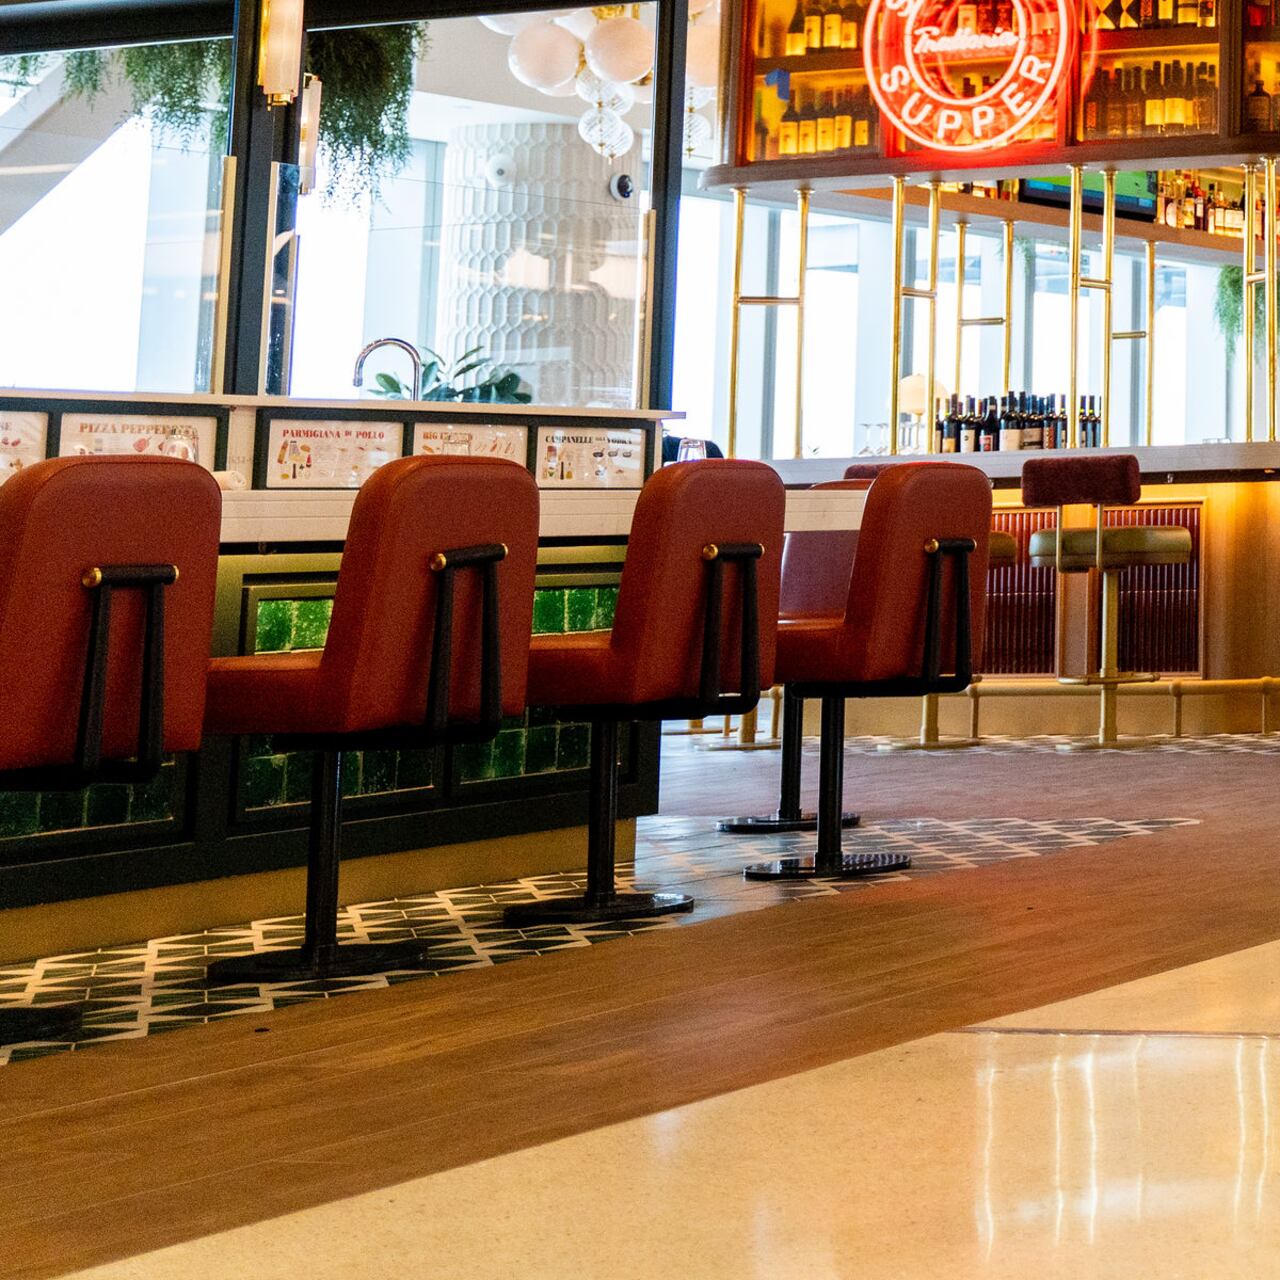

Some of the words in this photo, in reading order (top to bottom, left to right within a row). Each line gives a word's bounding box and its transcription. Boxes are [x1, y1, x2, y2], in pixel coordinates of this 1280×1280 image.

[913, 25, 1020, 55] Trattoria
[880, 55, 1052, 139] SUPPER
[79, 422, 117, 433] PIZZA
[282, 429, 341, 439] PARMIGIANA
[356, 431, 385, 440] POLLO
[545, 435, 593, 444] CAMPANELLE
